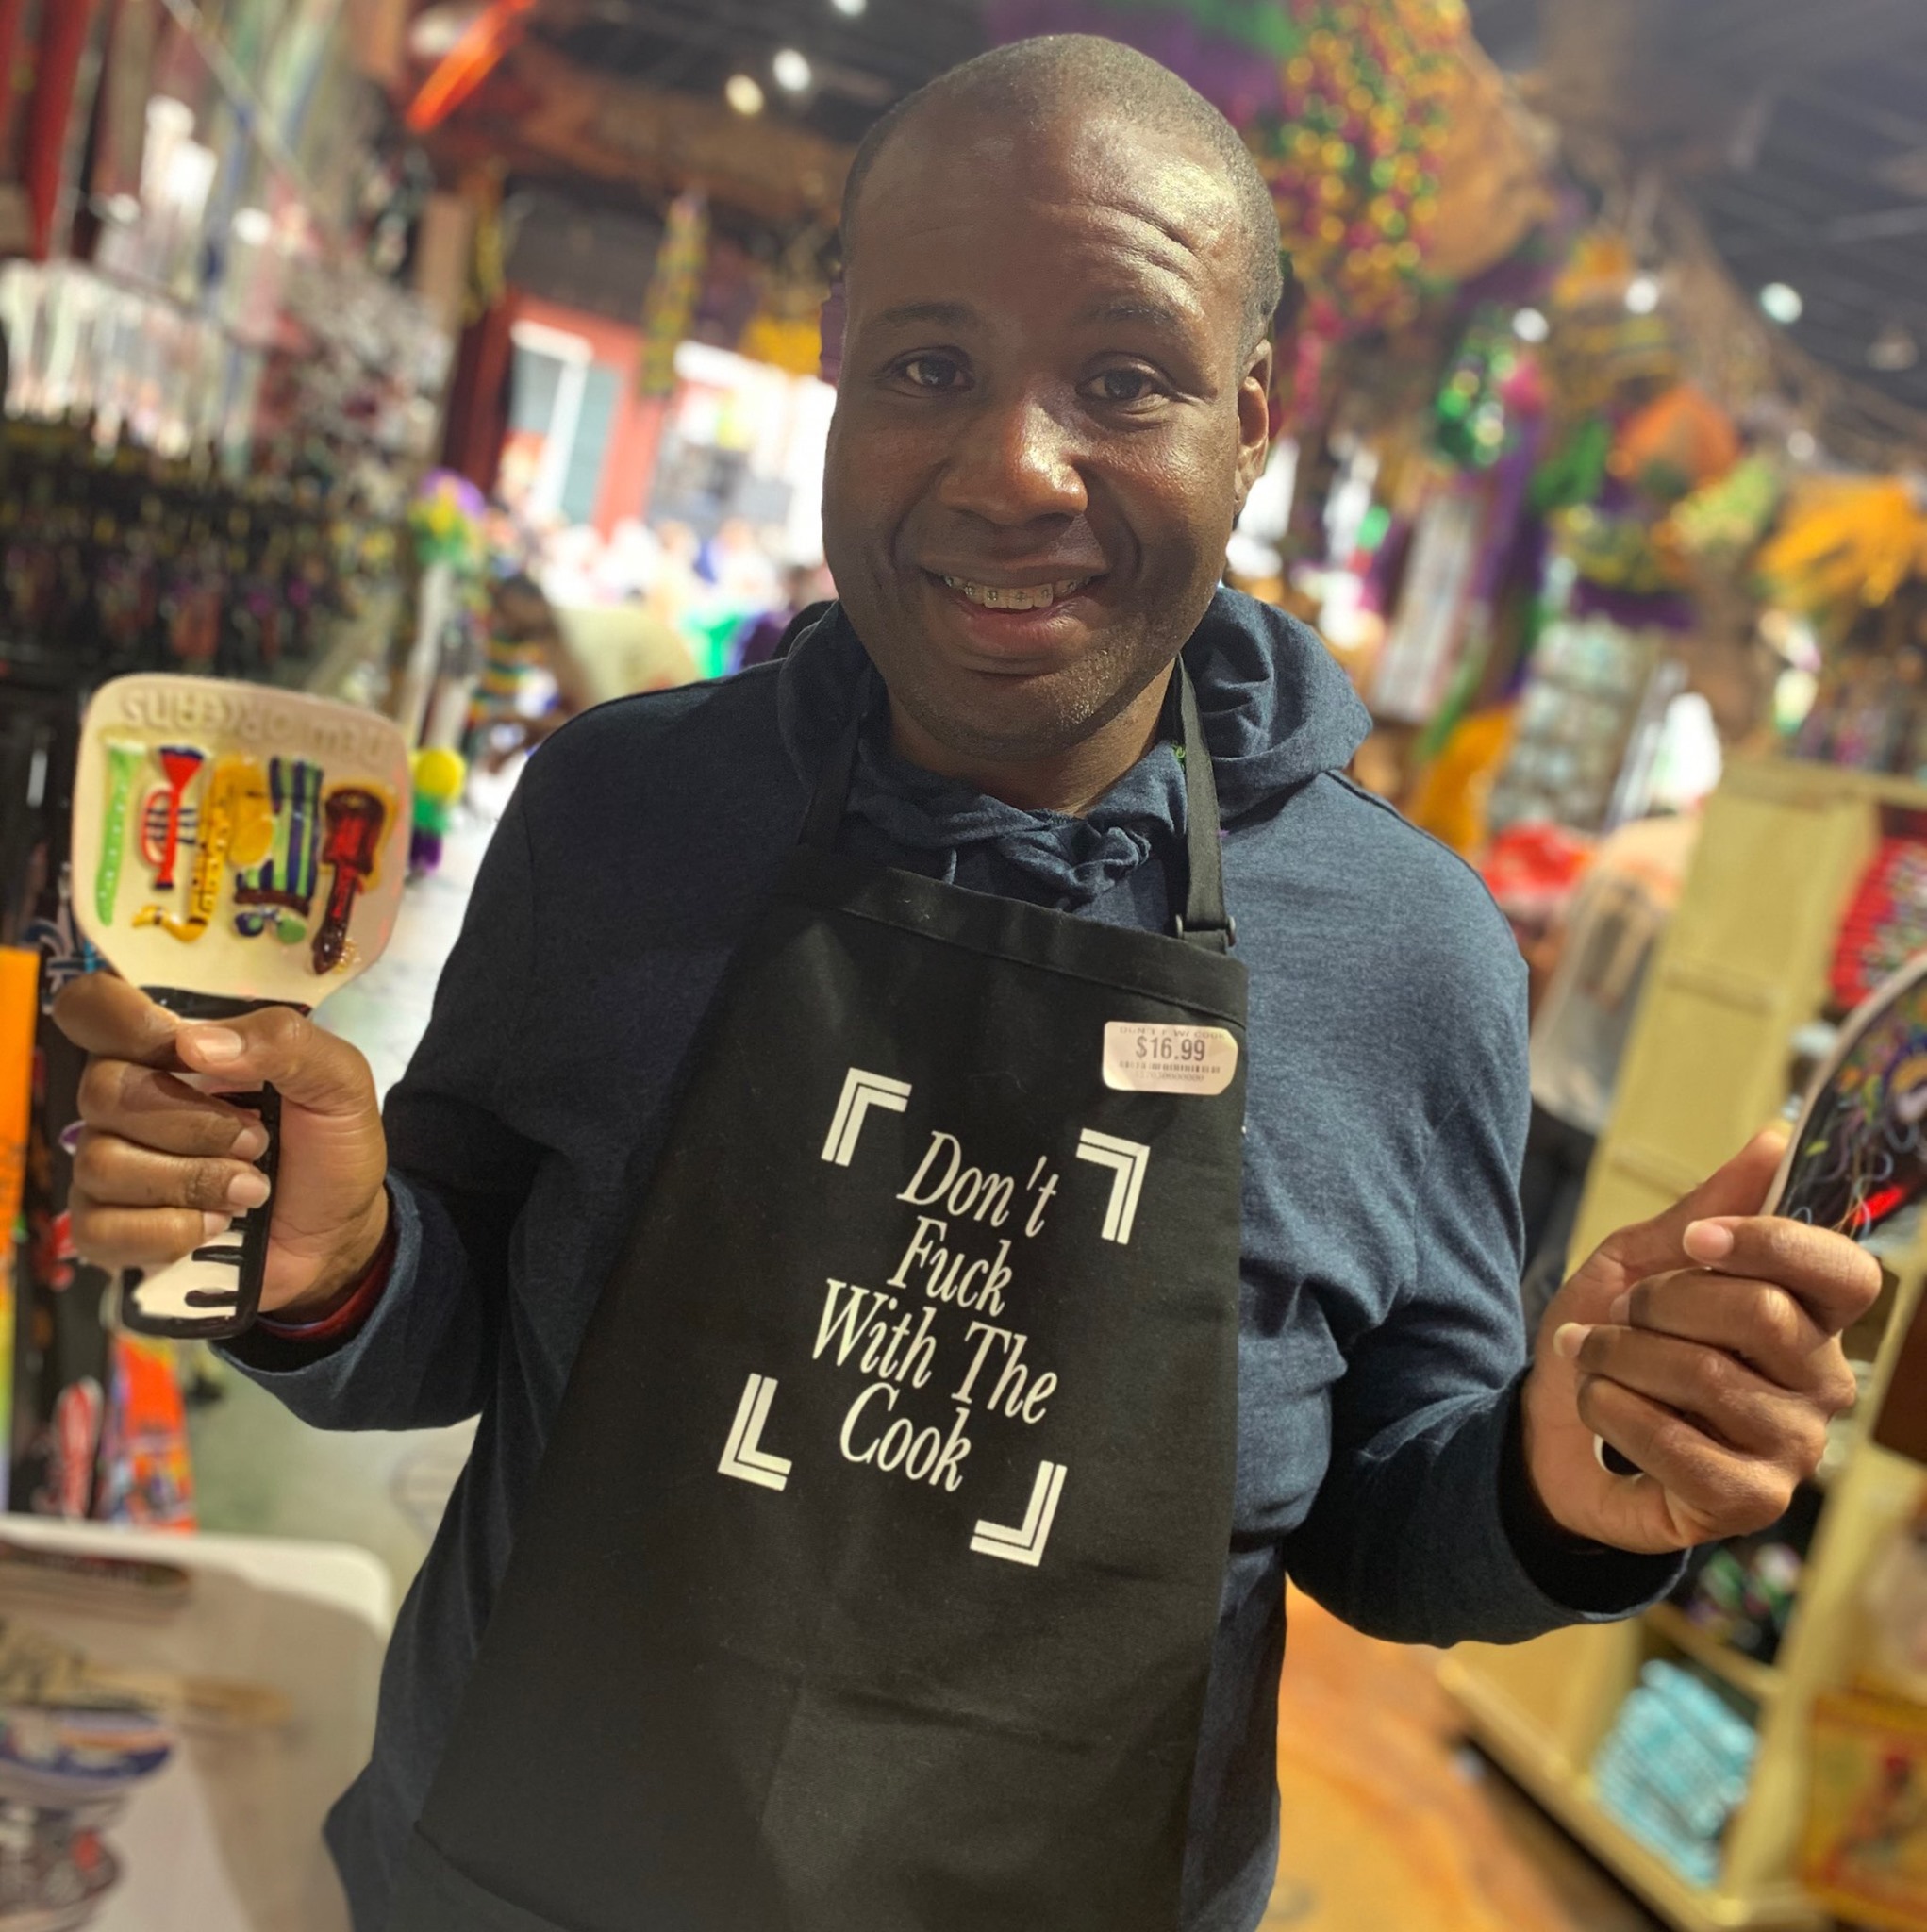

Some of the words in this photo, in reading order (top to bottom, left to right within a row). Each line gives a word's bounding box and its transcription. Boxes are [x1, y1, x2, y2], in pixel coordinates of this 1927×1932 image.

[1135, 1035, 1206, 1061] $16.99
[894, 1129, 1060, 1238] Don't
[886, 1215, 1013, 1317] Fuck
[811, 1277, 938, 1389] With
[950, 1321, 1059, 1424] The
[839, 1381, 972, 1492] Cook
